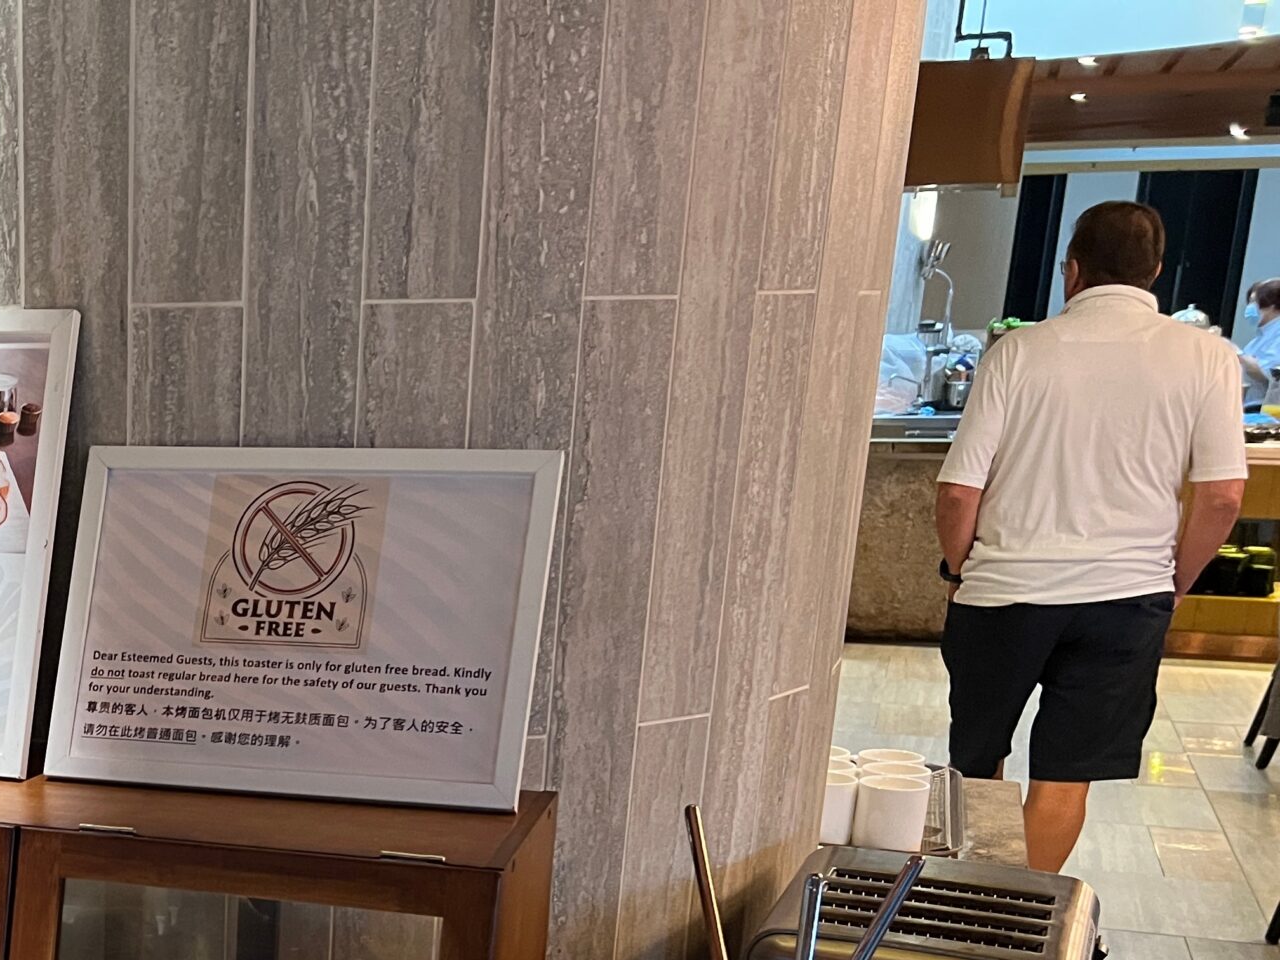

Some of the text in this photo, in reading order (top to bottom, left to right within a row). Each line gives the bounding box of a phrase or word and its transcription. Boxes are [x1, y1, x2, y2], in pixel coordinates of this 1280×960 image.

[231, 598, 336, 621] GLUTEN
[254, 620, 306, 637] FREE
[93, 650, 492, 681] Dear Esteemed Guests, this toaster is only for gluten free bread. Kindly
[88, 681, 214, 700] for your understanding.
[91, 667, 487, 697] do not toast regular bread here for the safety of our guests. Thank you
